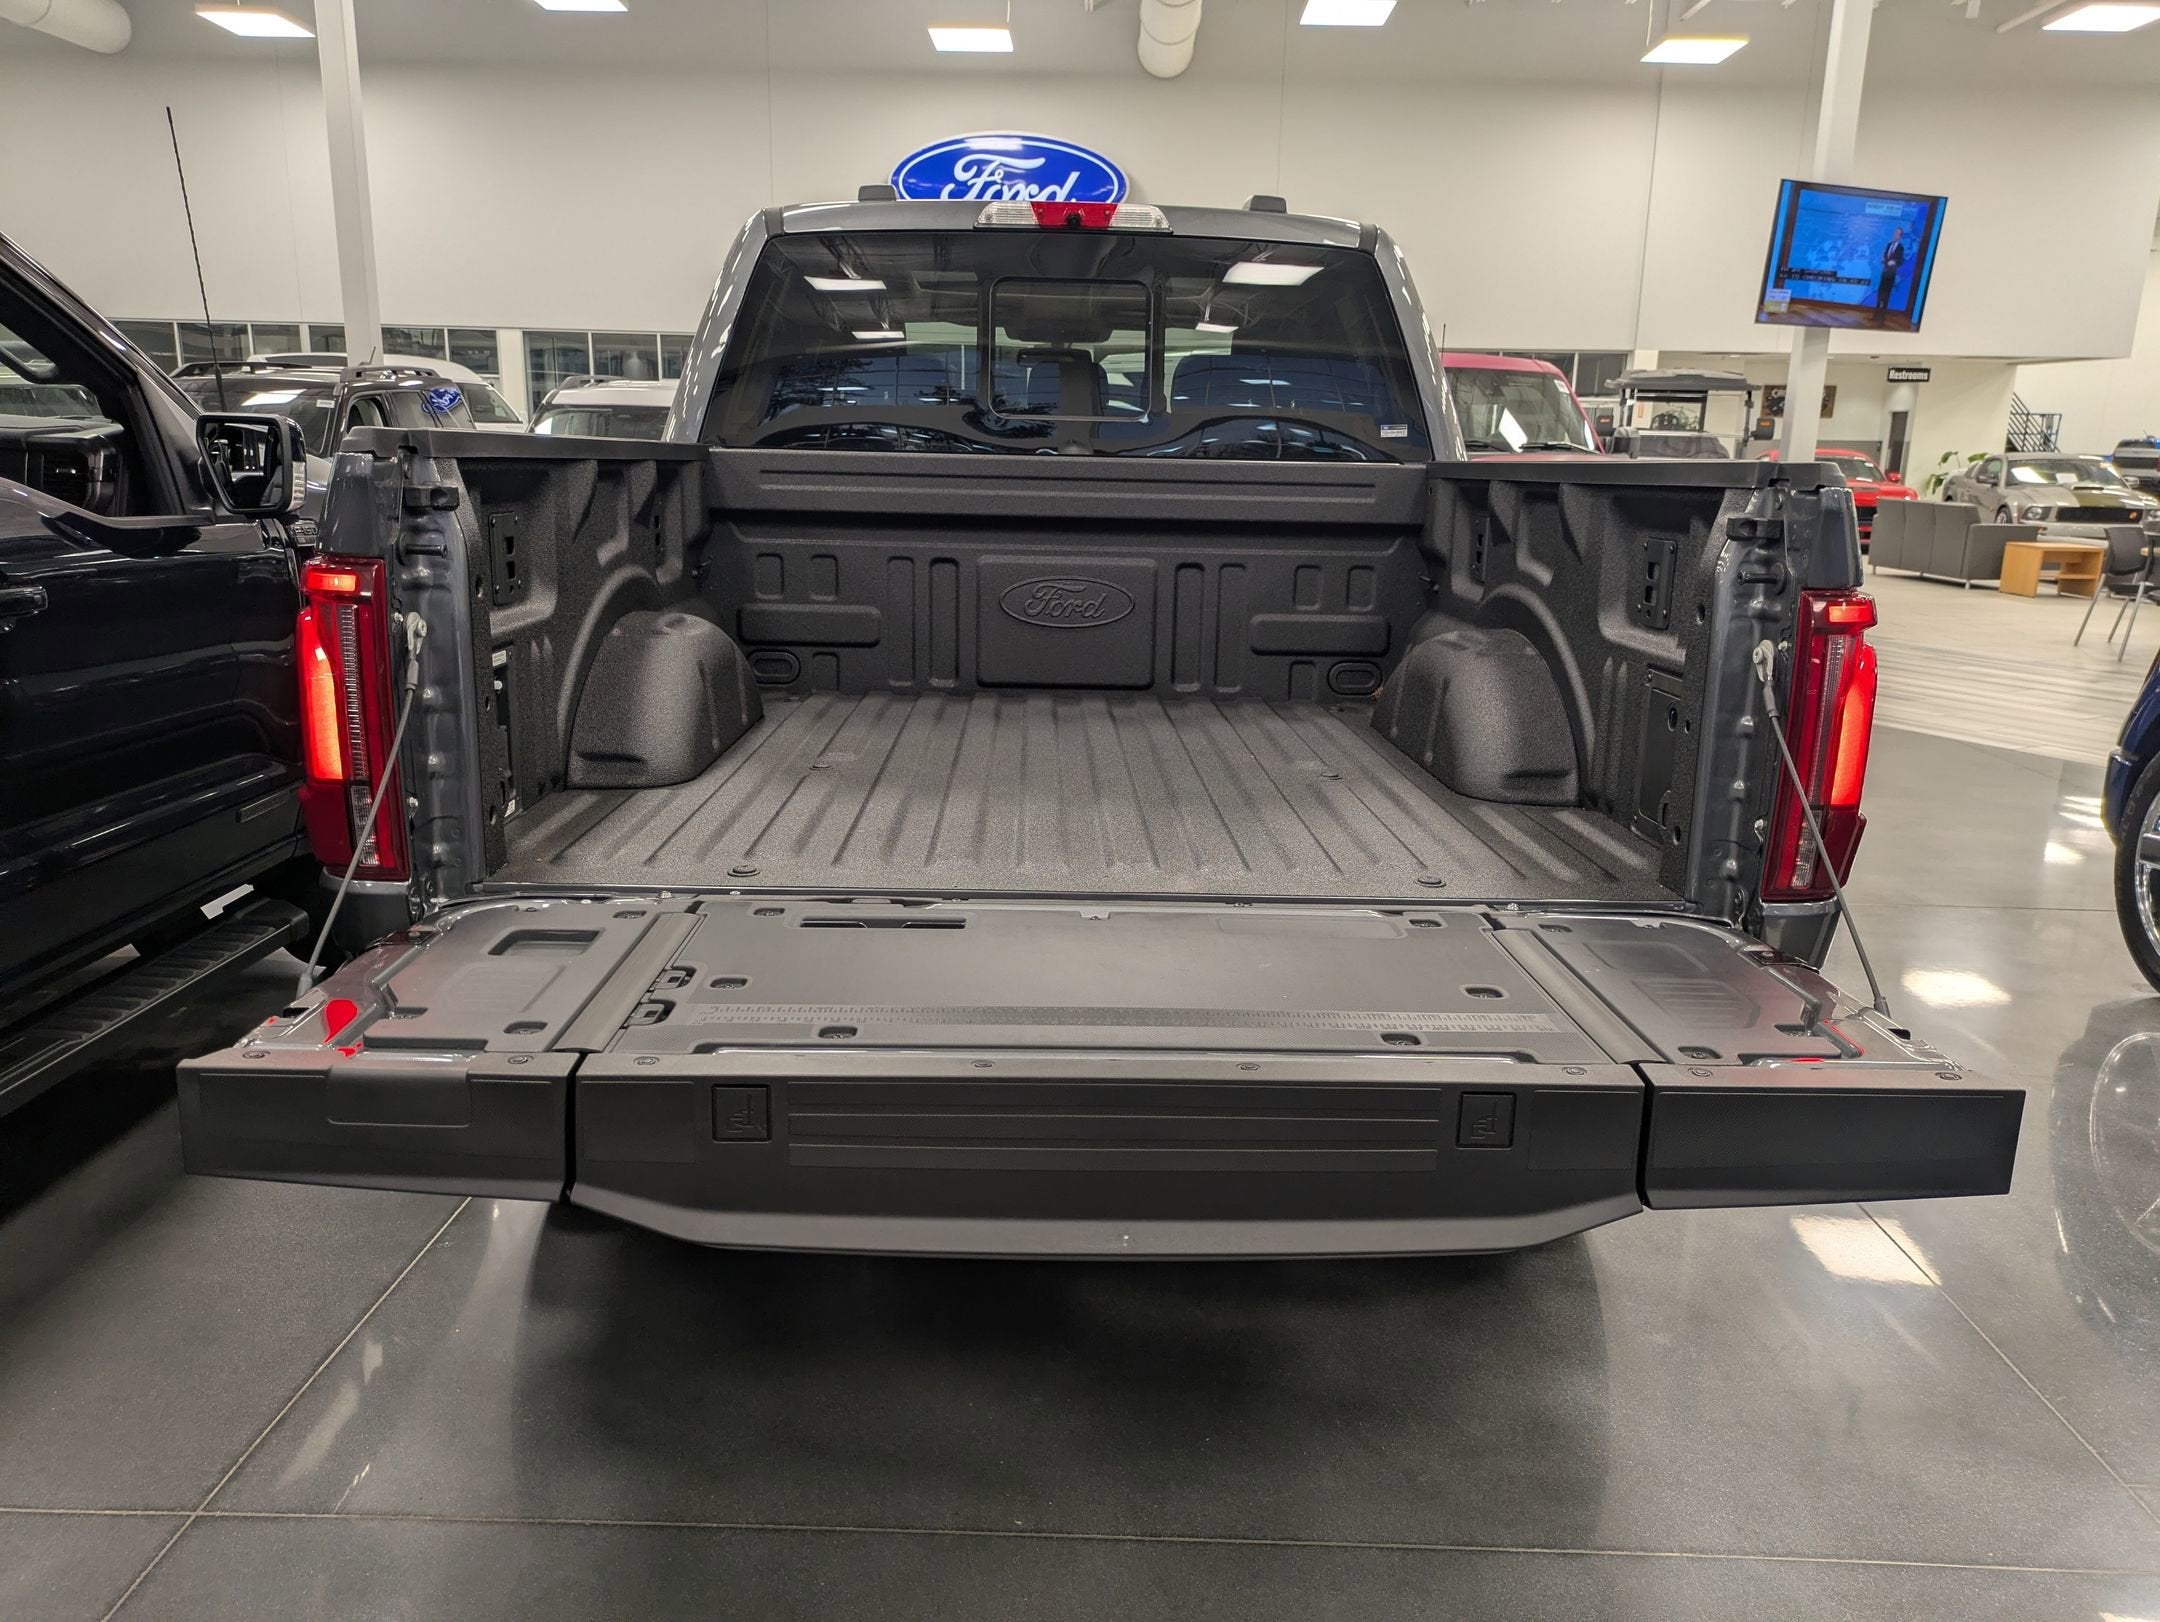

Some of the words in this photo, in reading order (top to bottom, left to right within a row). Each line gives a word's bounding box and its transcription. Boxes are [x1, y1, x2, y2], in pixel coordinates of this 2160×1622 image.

[940, 153, 1081, 201] Ford
[1888, 369, 1929, 380] Restrooms
[1024, 582, 1108, 619] Ford
